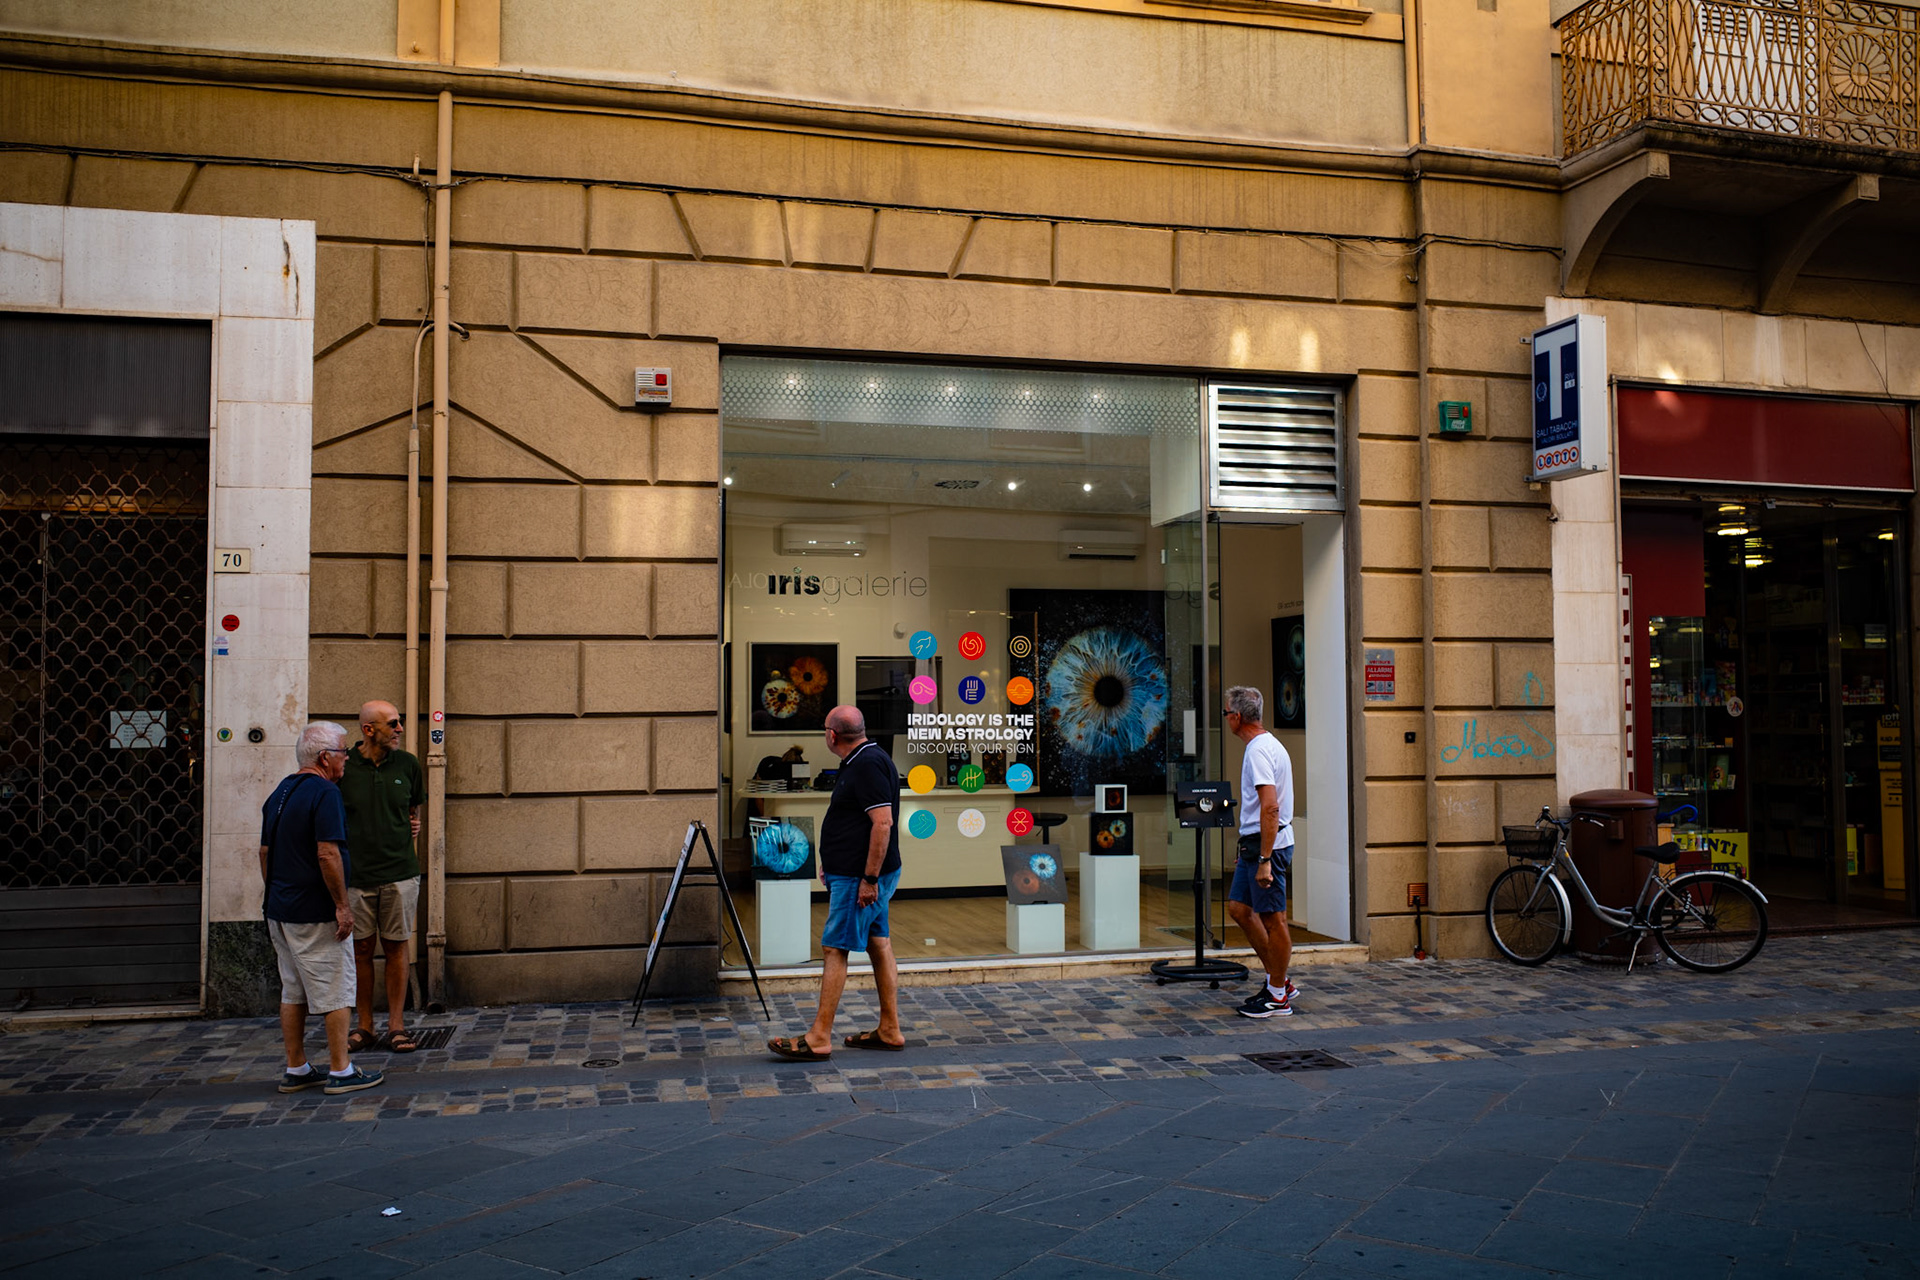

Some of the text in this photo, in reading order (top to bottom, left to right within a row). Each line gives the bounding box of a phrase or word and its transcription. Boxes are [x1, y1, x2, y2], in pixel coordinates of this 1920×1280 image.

[1535, 323, 1577, 421] T
[1537, 447, 1579, 469] LOTTO
[222, 553, 242, 567] 70
[768, 566, 927, 604] irisgalerie
[907, 713, 1034, 726] IRIDOLOGY IS THE
[907, 728, 1034, 740] NEW ASTROLOGY
[907, 742, 1034, 754] DISCOVER YOUR SIGN
